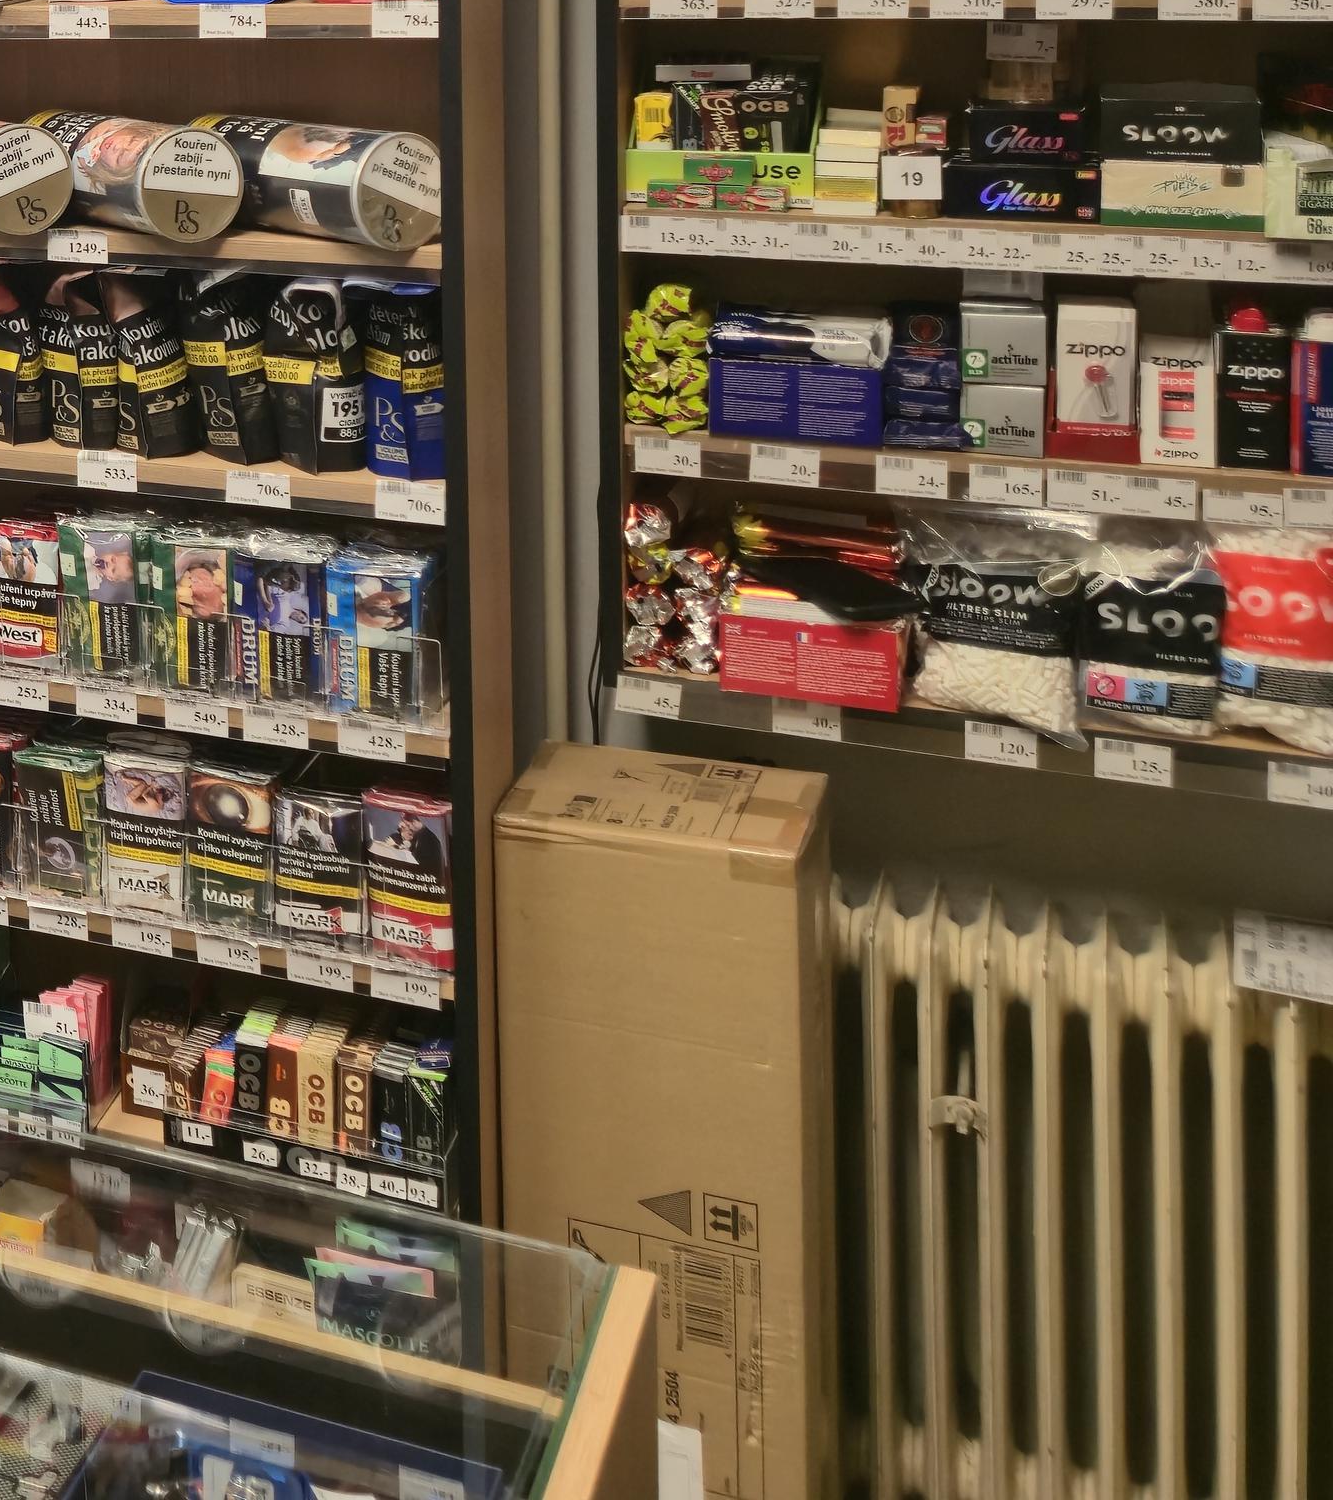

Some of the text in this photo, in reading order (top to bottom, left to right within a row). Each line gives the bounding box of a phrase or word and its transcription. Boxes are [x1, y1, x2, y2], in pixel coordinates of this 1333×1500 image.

[229, 13, 263, 27] 784,-
[173, 136, 218, 153] Kouření
[152, 164, 231, 182] přestaňte nyní
[900, 171, 924, 187] 19
[68, 241, 108, 256] 1249,-
[194, 711, 226, 726] 549,-
[999, 742, 1038, 756] 120,-
[117, 874, 170, 895] MARK
